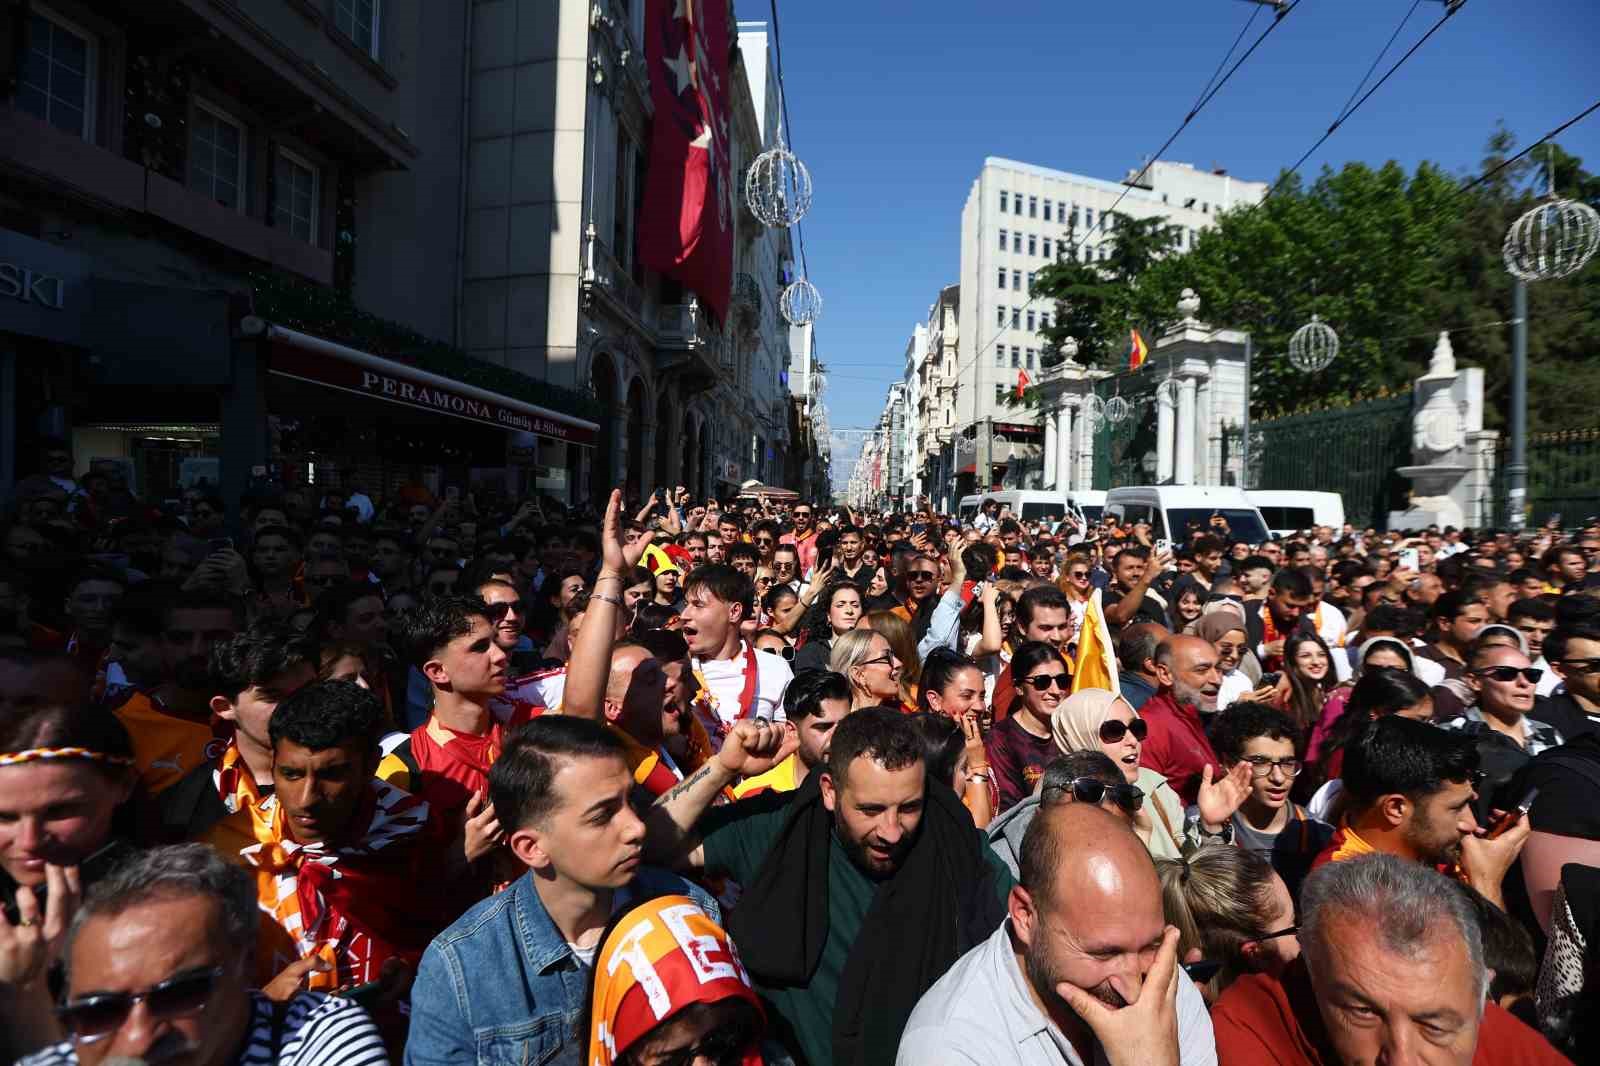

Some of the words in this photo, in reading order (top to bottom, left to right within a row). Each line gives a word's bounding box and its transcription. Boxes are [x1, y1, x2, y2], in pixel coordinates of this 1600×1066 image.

[0, 262, 64, 310] SKI
[361, 370, 491, 419] PERAMONA
[543, 422, 568, 438] Silver
